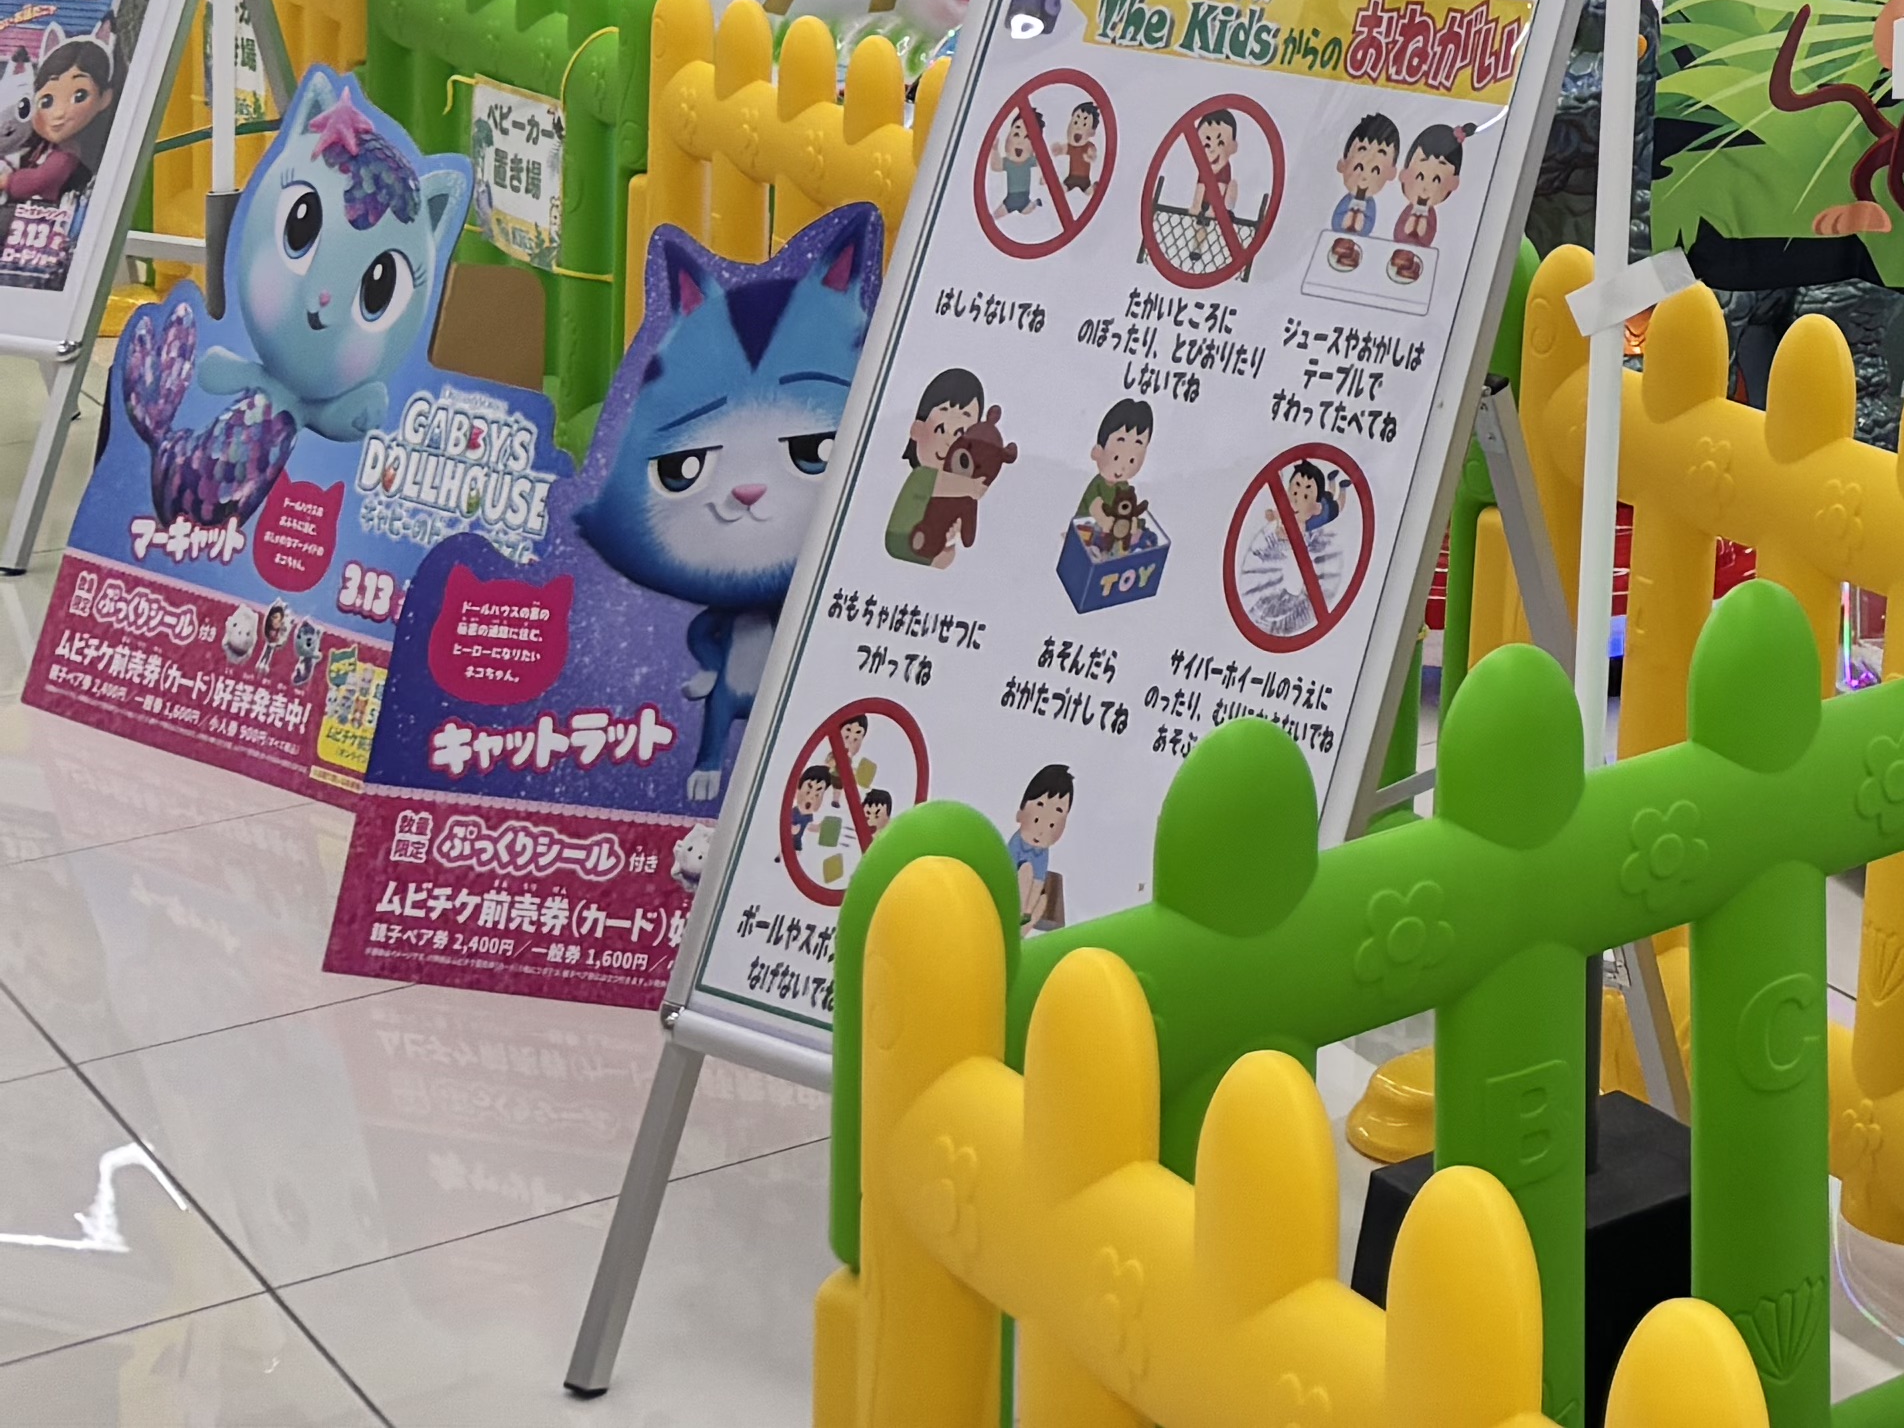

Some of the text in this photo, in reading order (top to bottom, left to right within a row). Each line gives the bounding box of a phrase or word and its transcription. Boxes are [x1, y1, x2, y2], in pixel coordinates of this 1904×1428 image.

[1279, 30, 1342, 72] からの
[492, 147, 543, 201] 置き場
[935, 288, 1047, 333] はしらないでね
[1125, 286, 1238, 335] たかいところに
[1077, 317, 1267, 380] のぼったり、とびおりたり
[1283, 316, 1426, 372] ジュースやおかしは
[1123, 360, 1201, 403] しないでね
[1303, 357, 1384, 402] テーブルで
[402, 395, 533, 473] GABBY'S
[1271, 388, 1399, 444] すわってたべてね
[357, 435, 551, 537] DOLLHOUSE
[131, 516, 246, 564] マーキャット
[343, 563, 394, 616] 3.13
[1100, 561, 1157, 599] TOY
[96, 584, 194, 642] ぷっくりシール
[826, 587, 988, 652] おもちゃはたいせつに
[452, 643, 541, 662] ヒーローになりたい
[464, 665, 520, 683] ネコちゃん。
[856, 644, 933, 687] つかってね
[1038, 636, 1119, 684] あそんだら
[1169, 647, 1334, 712] サイバーホイールのうえに
[999, 678, 1130, 736] おかたづけしてね
[433, 710, 674, 771] キャットラット
[441, 823, 658, 874] ぷっくりシール 付き
[736, 904, 837, 964] ボールやスポ
